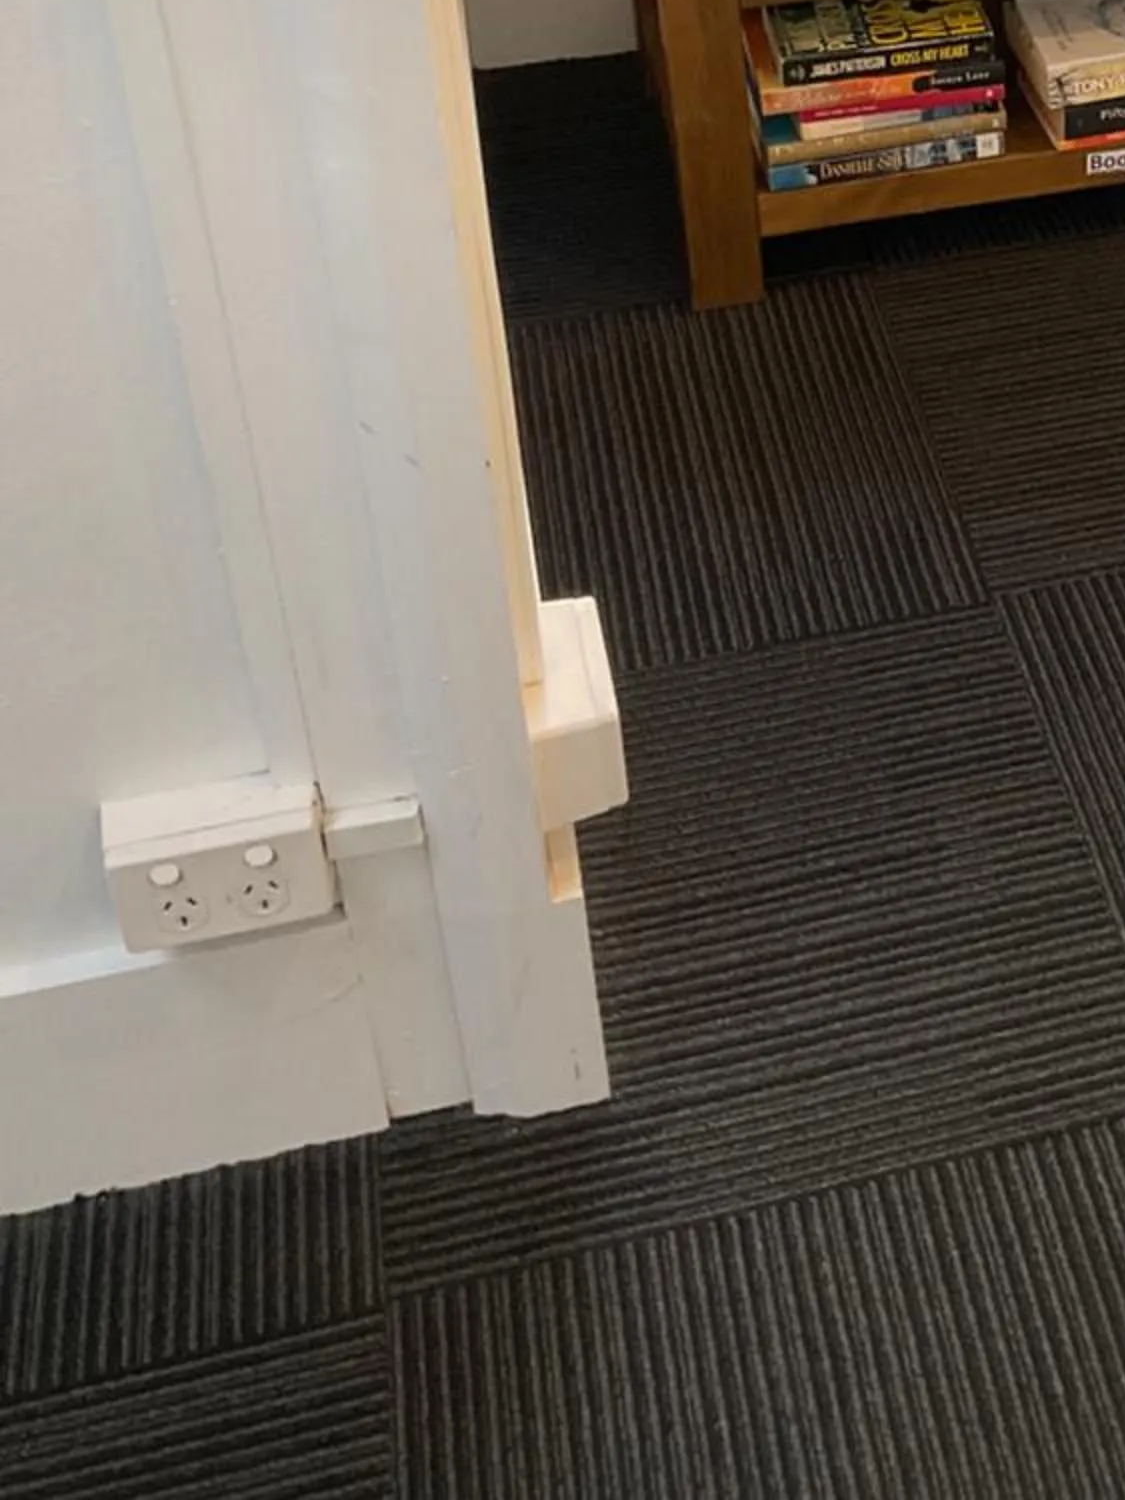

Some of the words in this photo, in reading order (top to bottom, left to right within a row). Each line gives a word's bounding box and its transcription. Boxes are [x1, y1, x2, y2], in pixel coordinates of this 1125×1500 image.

[811, 61, 838, 78] JAMES
[890, 49, 921, 67] CROSS
[922, 47, 939, 62] MY
[939, 44, 970, 61] HEART
[1074, 77, 1115, 94] TONY
